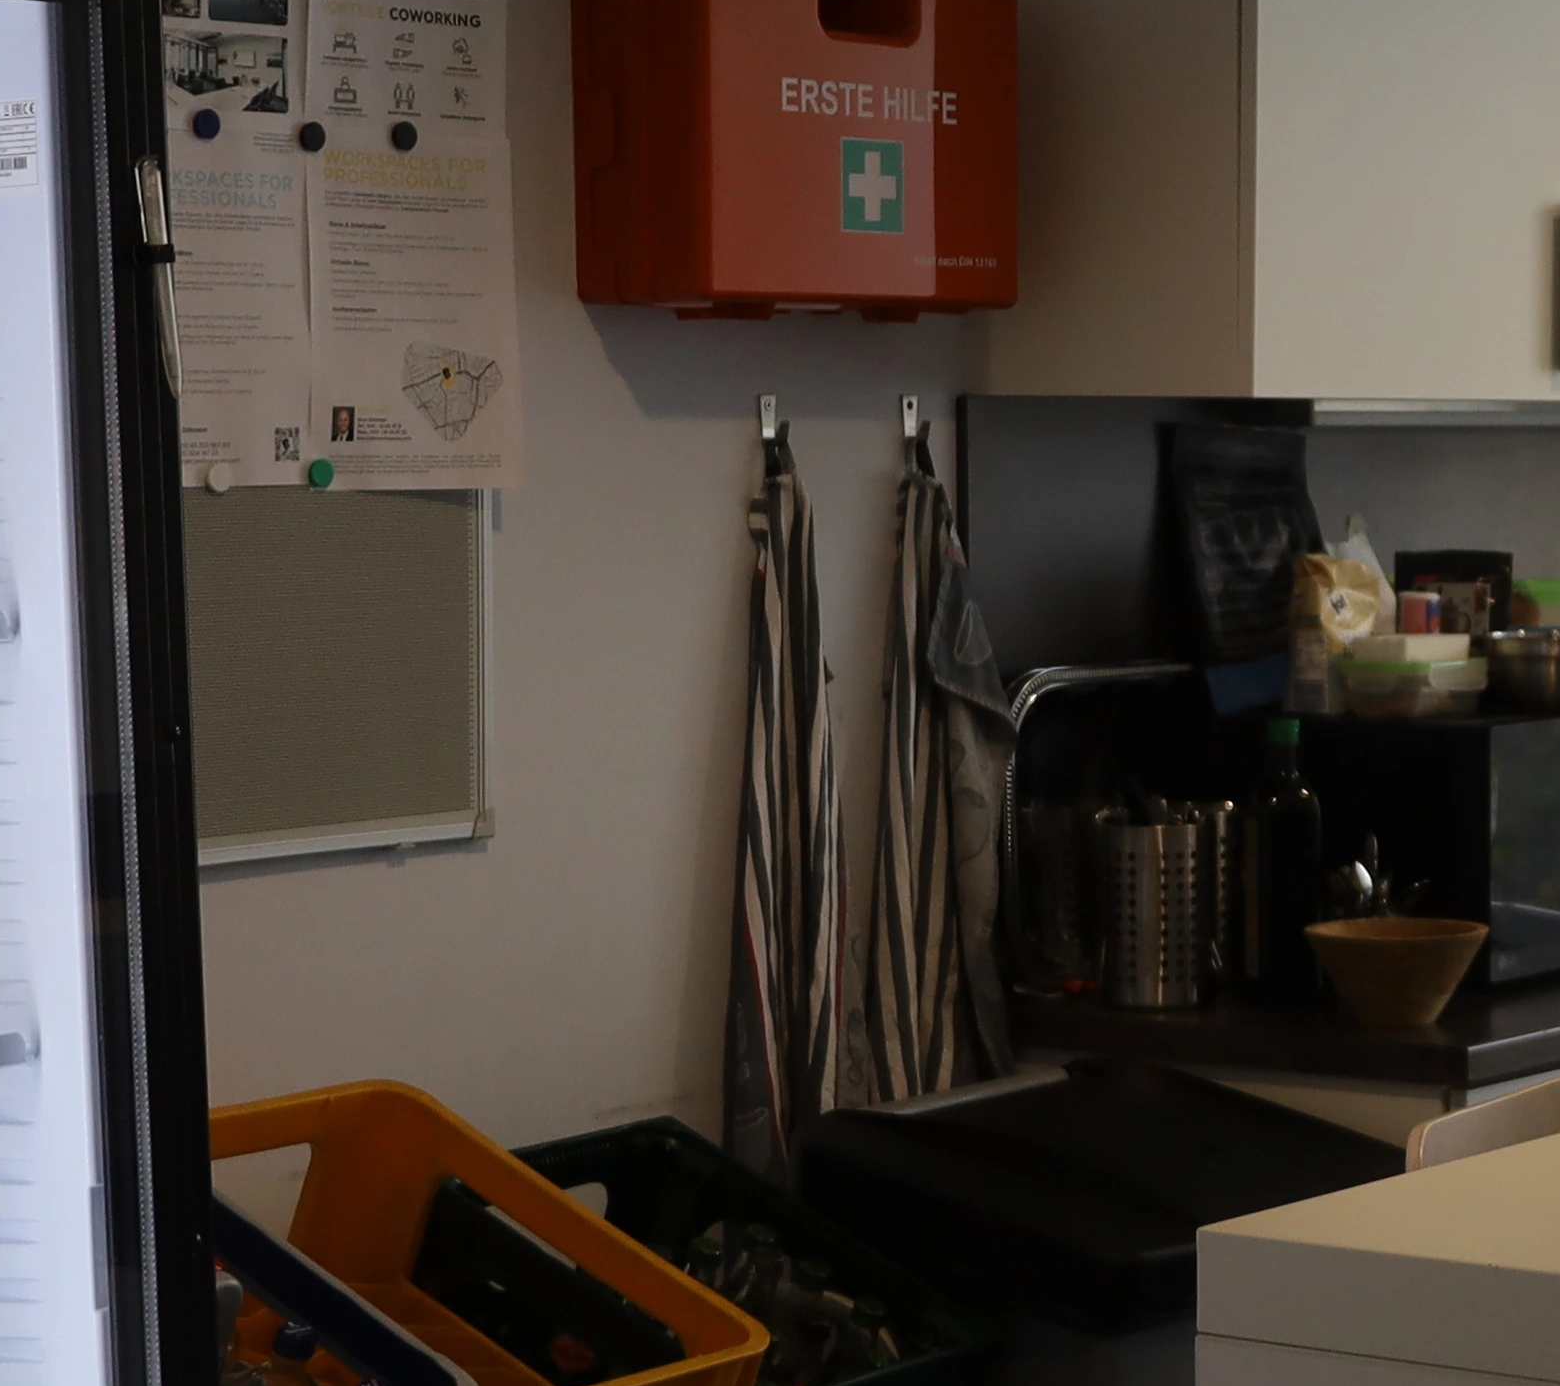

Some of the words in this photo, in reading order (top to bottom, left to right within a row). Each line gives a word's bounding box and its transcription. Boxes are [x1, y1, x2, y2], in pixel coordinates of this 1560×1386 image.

[389, 6, 482, 29] COWORKING
[780, 76, 875, 119] ERSTE
[882, 86, 959, 127] HILFE
[448, 157, 487, 175] FOR
[171, 168, 255, 192] KSPACES
[259, 174, 293, 192] FOR
